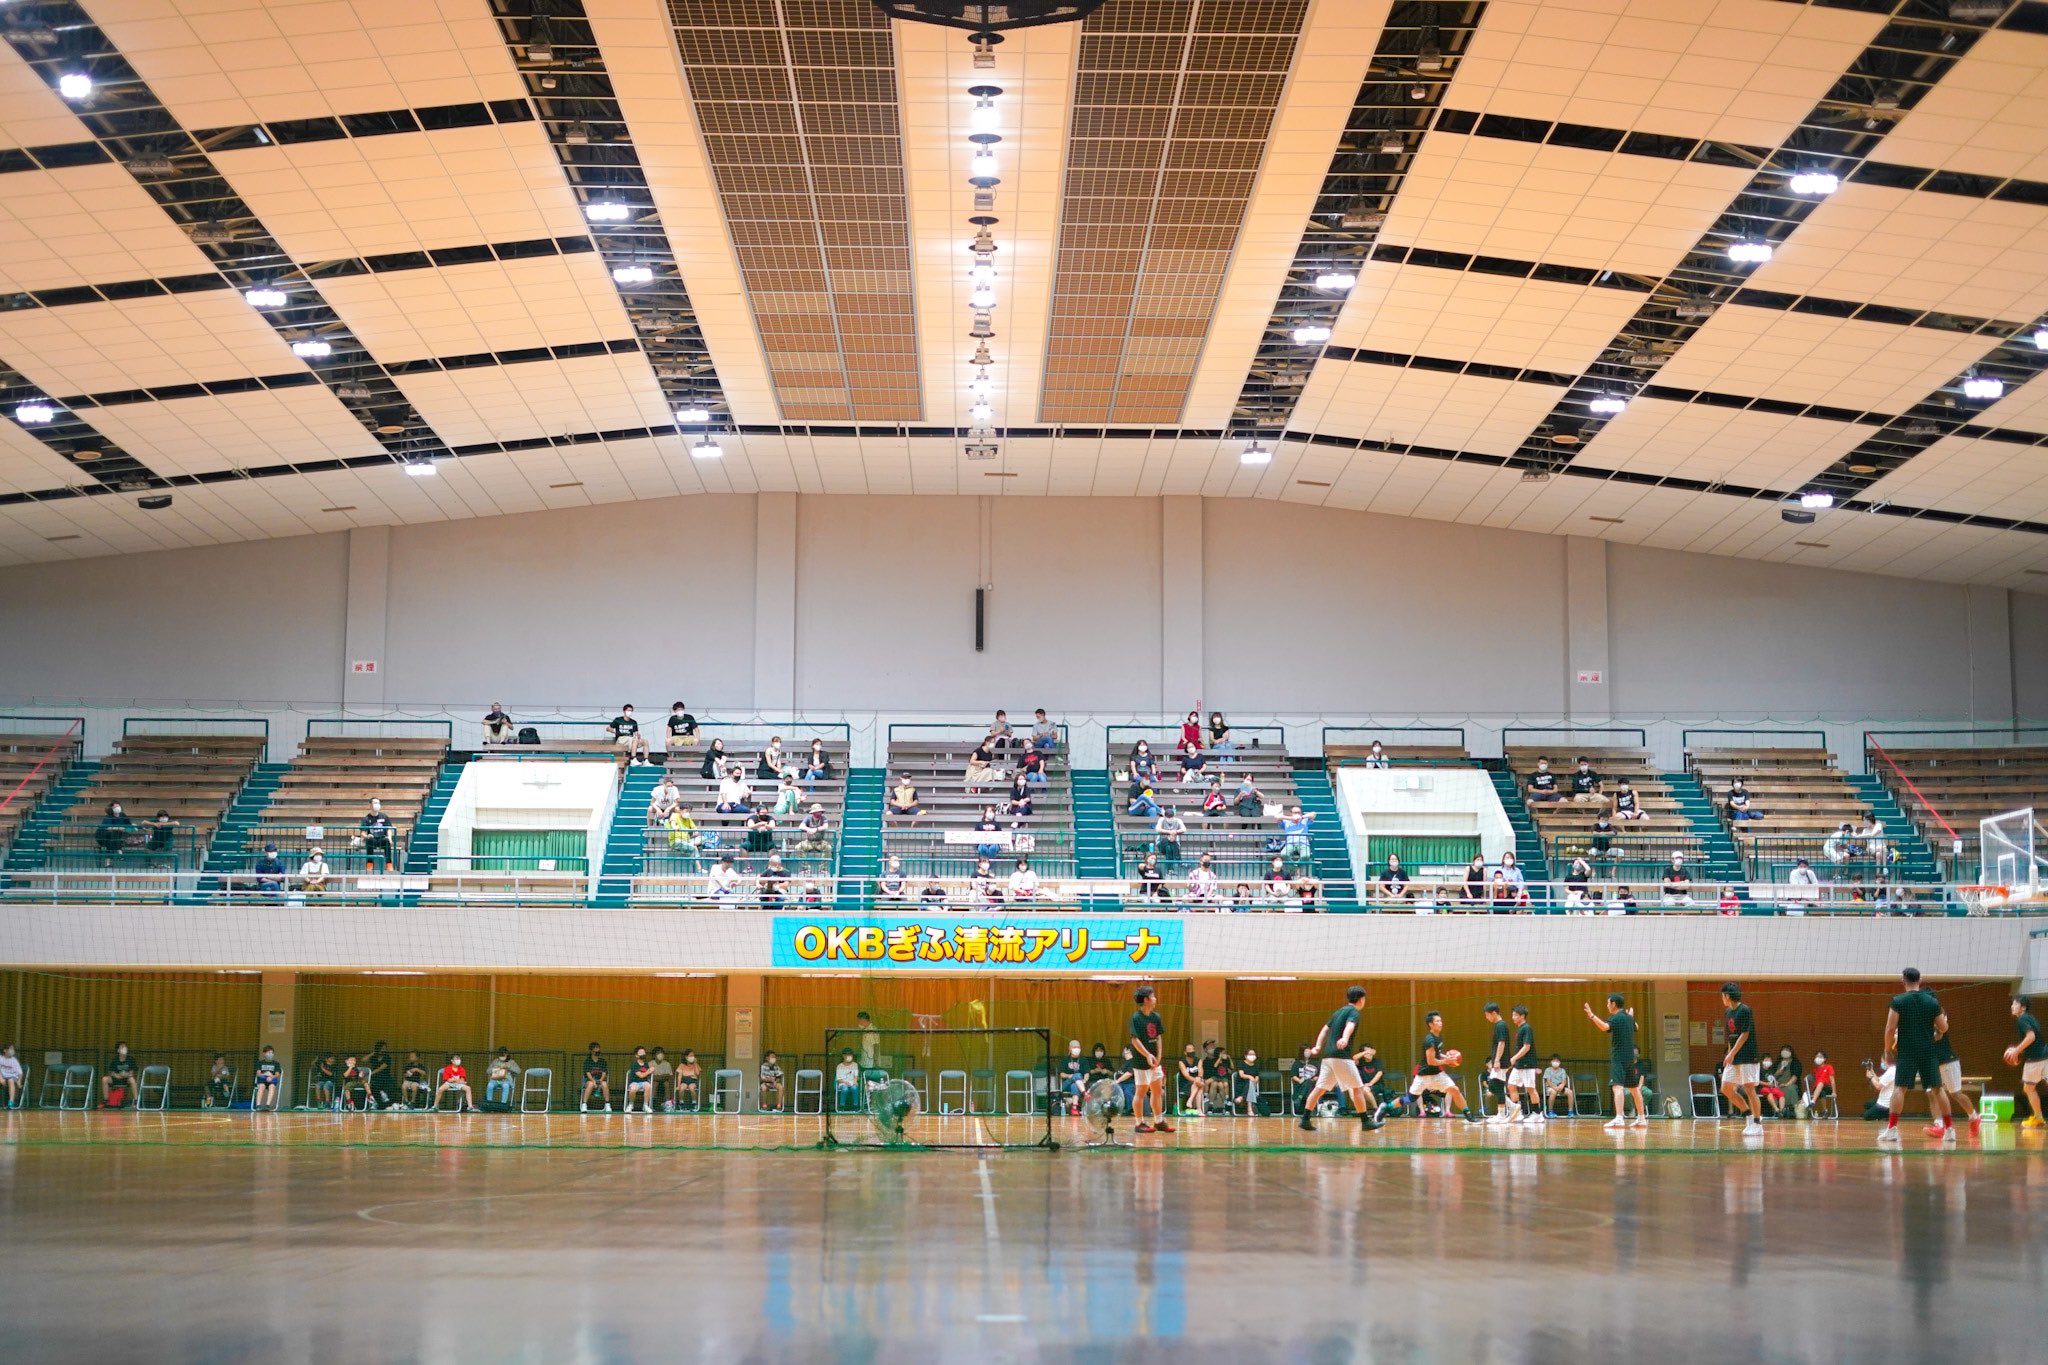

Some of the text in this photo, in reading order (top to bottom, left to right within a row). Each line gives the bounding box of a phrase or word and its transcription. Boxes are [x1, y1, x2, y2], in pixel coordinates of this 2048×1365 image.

[794, 924, 1161, 963] OKBぎふ清流アリーナ
